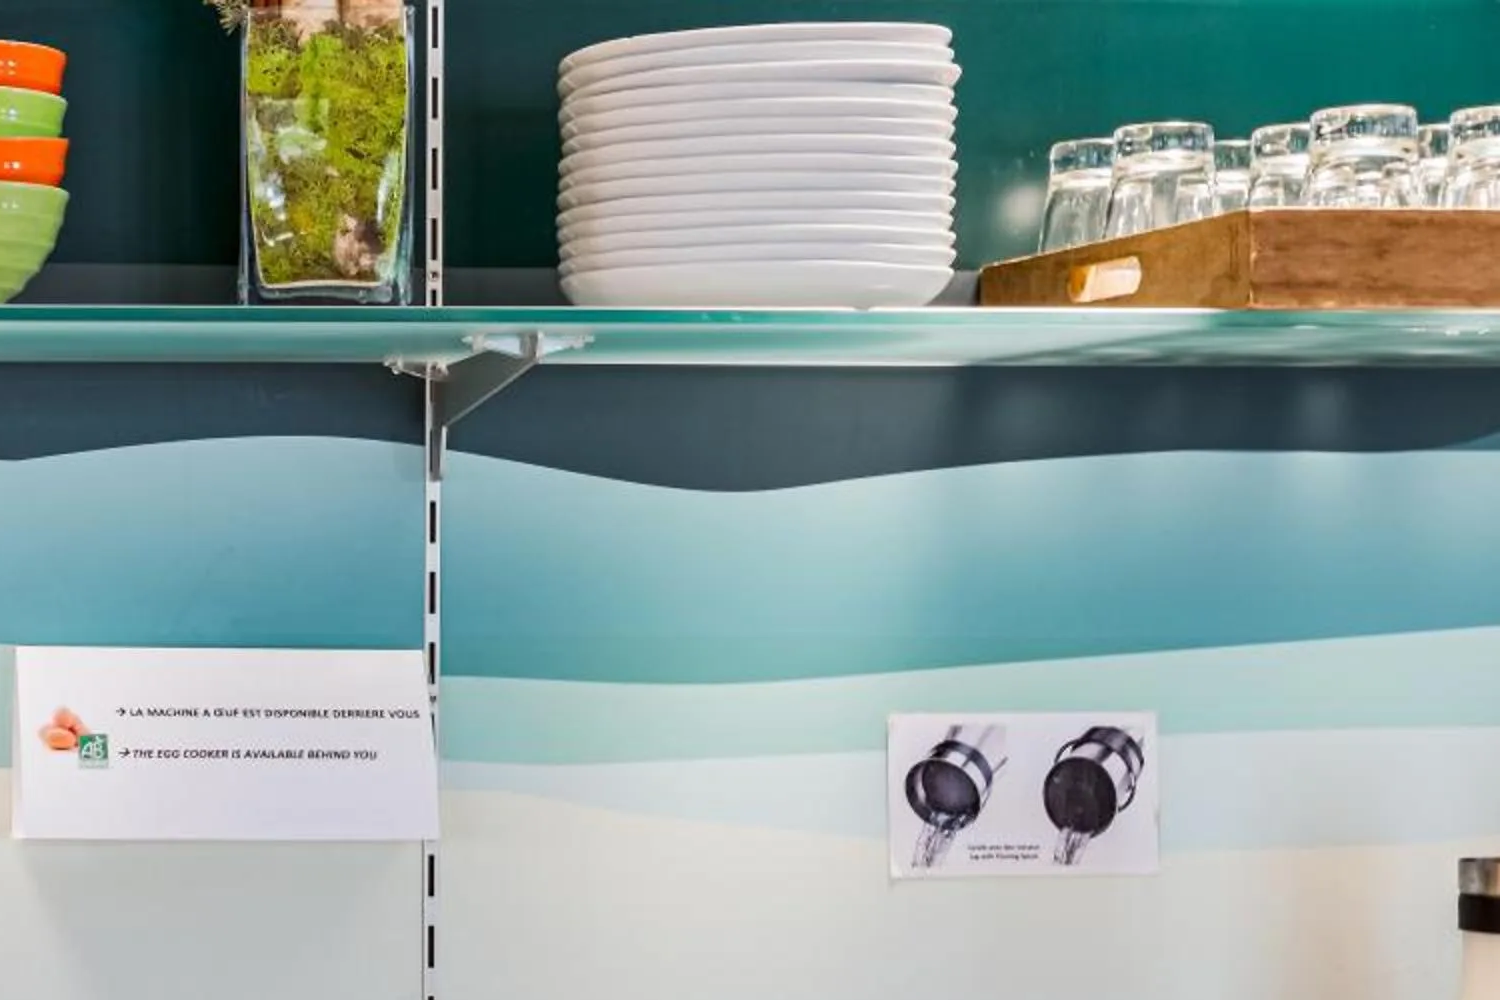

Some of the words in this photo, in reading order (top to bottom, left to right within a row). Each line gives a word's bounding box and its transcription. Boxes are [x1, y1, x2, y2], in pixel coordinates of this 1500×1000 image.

[129, 707, 144, 717] LA
[147, 707, 199, 718] MACHINE
[241, 708, 262, 718] EST
[264, 708, 329, 719] DISPONIBLE
[332, 709, 385, 719] DERRIERE
[388, 709, 420, 719] VOUS
[132, 749, 155, 760] THE
[156, 749, 181, 760] EGG
[183, 749, 229, 760] COOKER
[231, 749, 241, 760] IS
[243, 749, 305, 760] AVAILABLE
[307, 750, 351, 760] BEHIND
[353, 750, 378, 761] YOU
